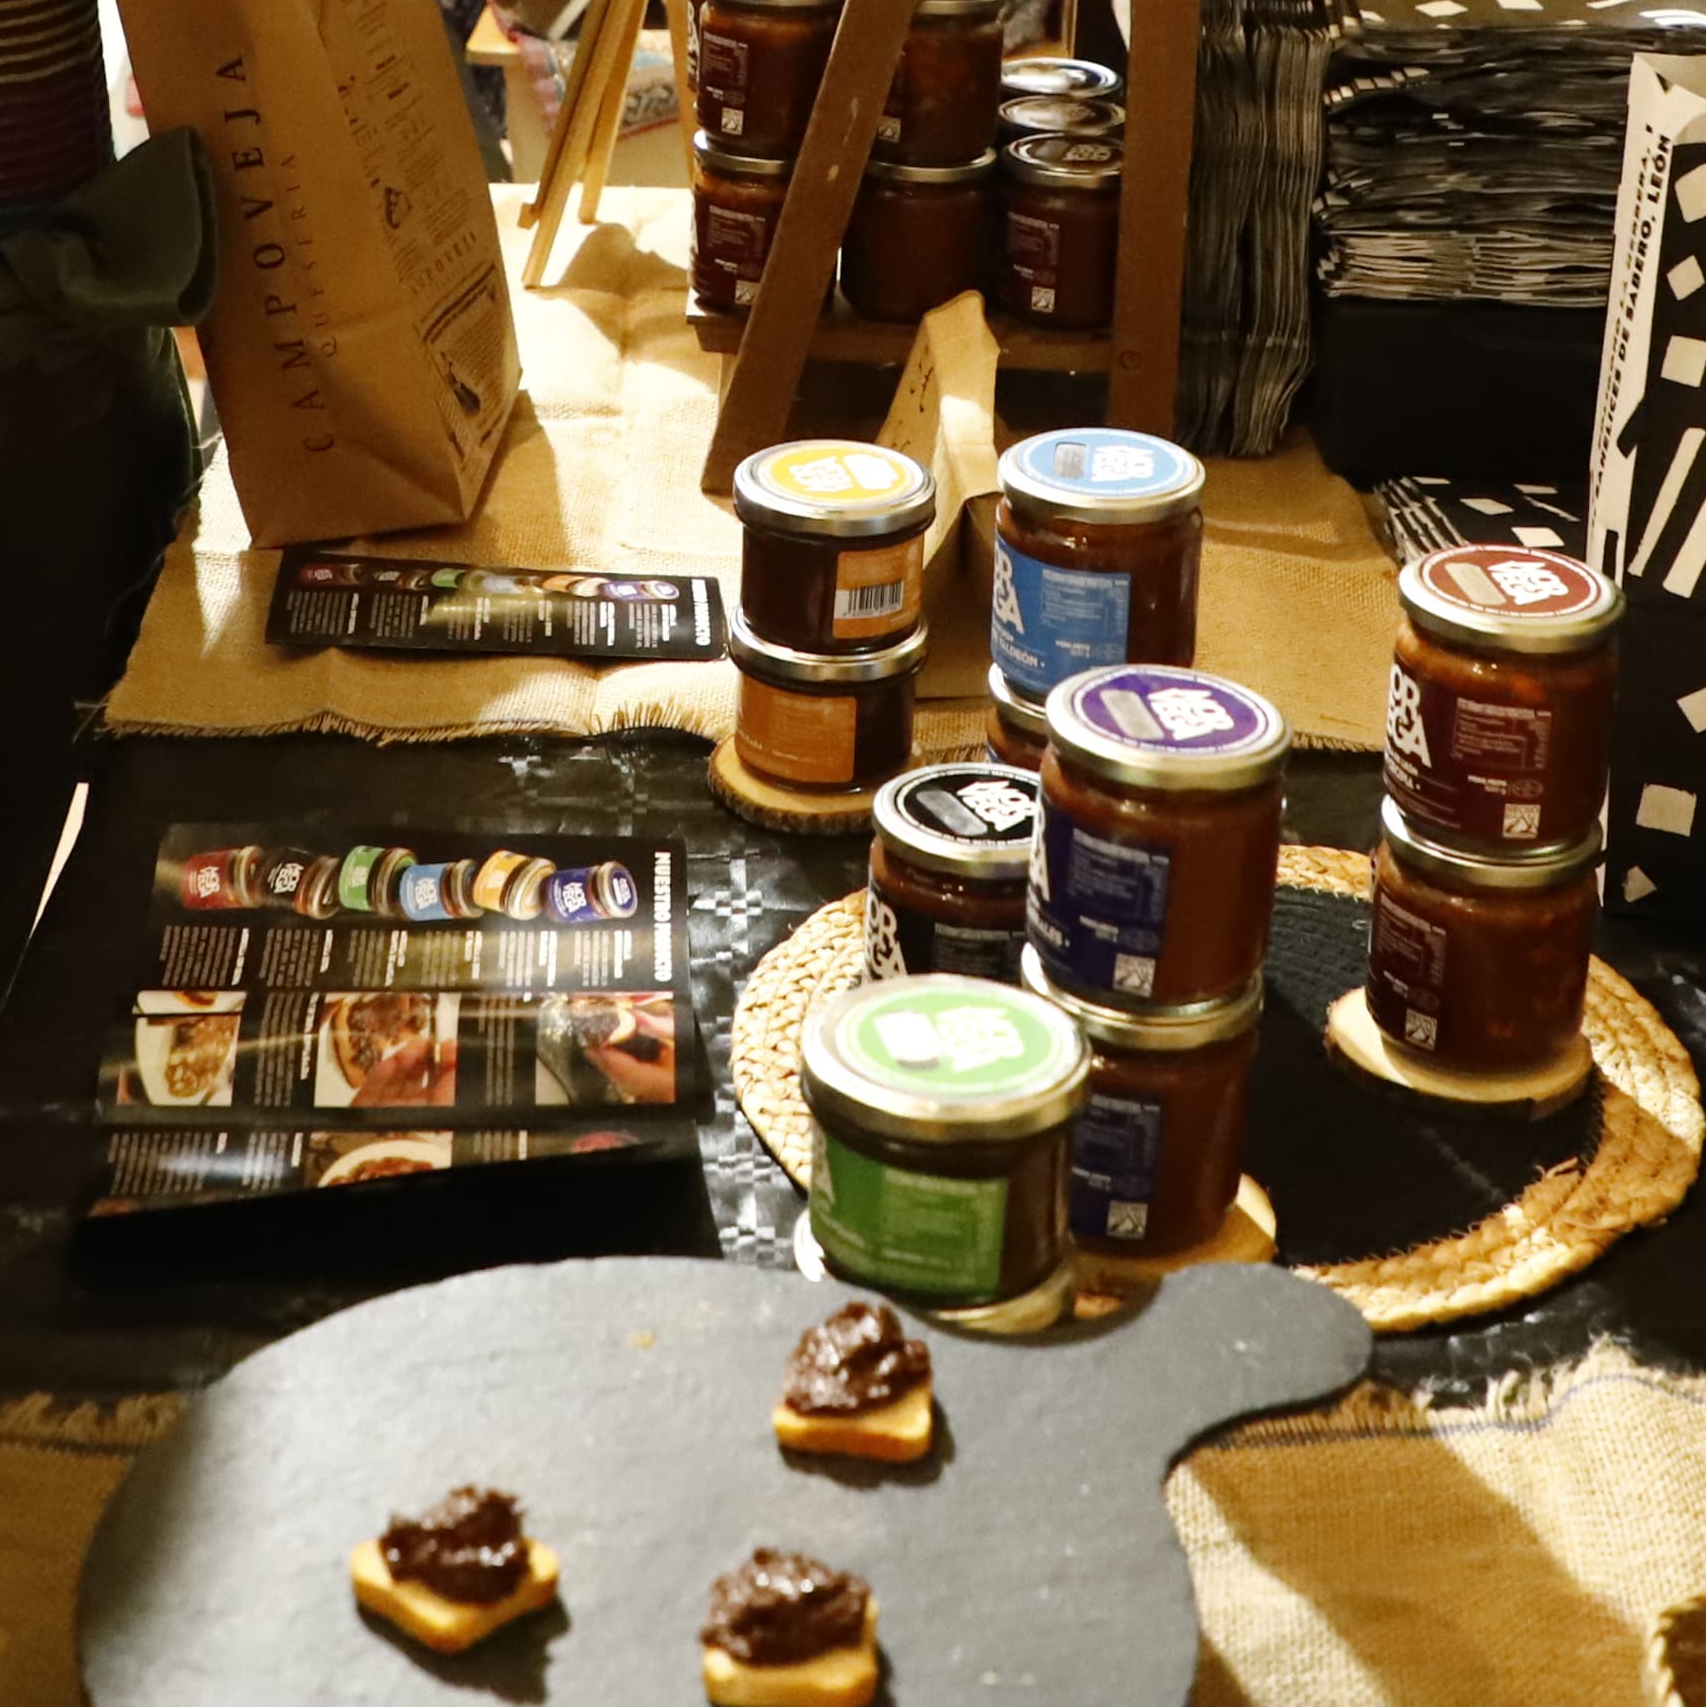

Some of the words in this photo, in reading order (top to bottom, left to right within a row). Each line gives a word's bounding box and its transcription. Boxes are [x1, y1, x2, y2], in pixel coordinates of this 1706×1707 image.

[216, 55, 335, 454] CAMPOVEJA
[1625, 211, 1656, 322] SABERO,
[1649, 133, 1672, 206] LEÓN
[654, 851, 672, 923] NUESTRO
